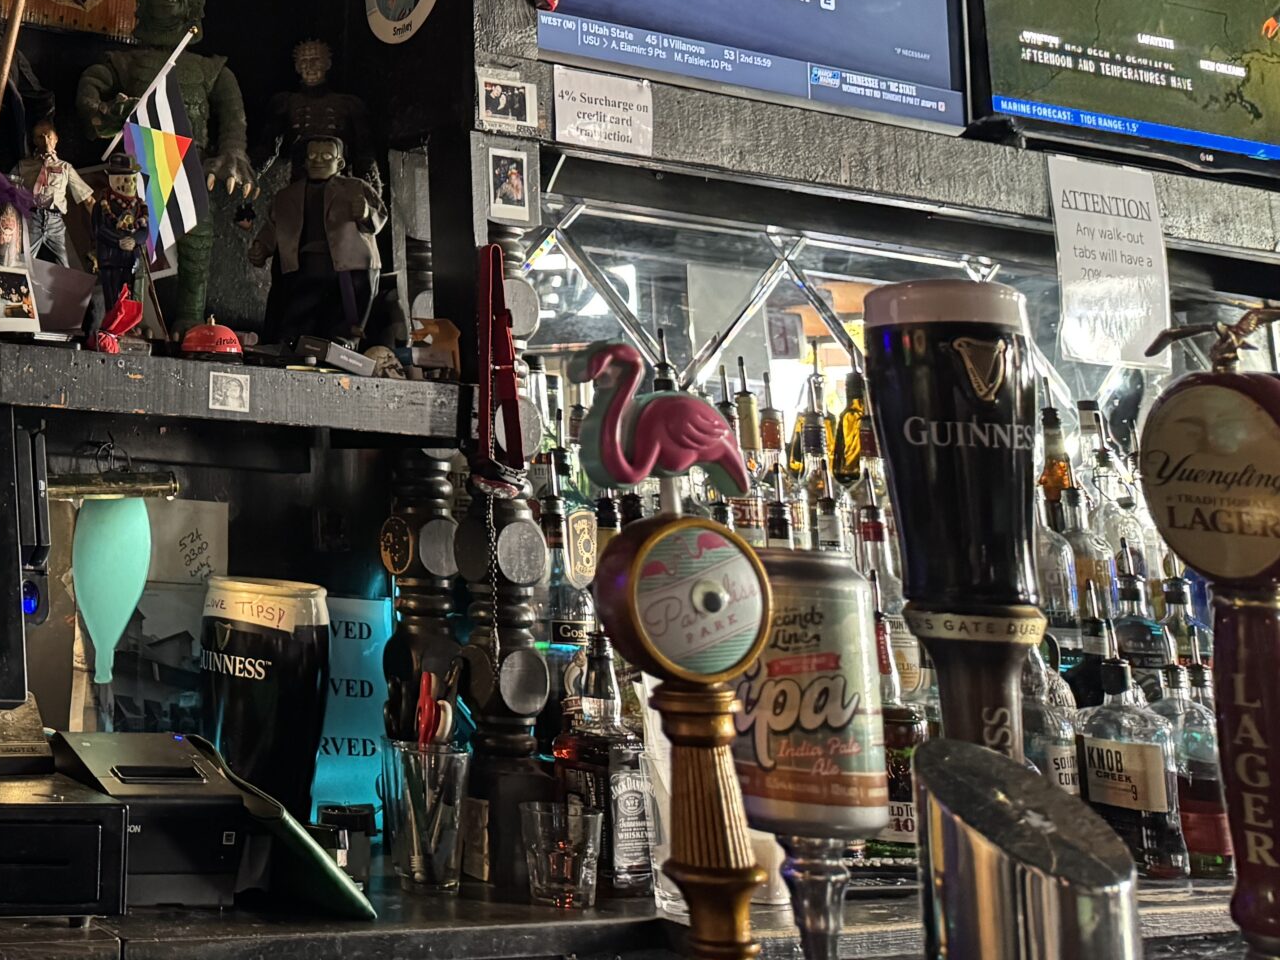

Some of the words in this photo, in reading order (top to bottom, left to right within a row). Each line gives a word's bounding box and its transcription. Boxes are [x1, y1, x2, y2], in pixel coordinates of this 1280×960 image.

[392, 20, 412, 36] Smiley
[540, 15, 562, 28] WEST
[588, 23, 610, 37] Utah
[610, 27, 634, 41] State
[645, 33, 658, 45] 45
[669, 38, 706, 55] Villanova
[723, 49, 735, 61] 53
[740, 54, 753, 64] 2nd
[583, 34, 600, 47] USU
[654, 48, 667, 59] Pts
[720, 60, 733, 72] Pts
[1021, 47, 1073, 70] AFTERNOON
[1078, 58, 1095, 73] AND
[1100, 61, 1167, 87] TEMPERATURES
[1170, 76, 1193, 91] HAVE
[558, 90, 576, 103] 4%
[579, 93, 634, 111] Surcharge
[636, 103, 650, 113] on
[576, 110, 608, 125] credit
[610, 115, 632, 127] card
[1001, 99, 1031, 115] MARINE
[1031, 104, 1074, 122] FORECAST:
[1080, 114, 1097, 126] TIDE
[1097, 116, 1125, 131] RANGE:
[1061, 188, 1152, 222] ATTENTION
[1075, 221, 1095, 240] Any
[1099, 226, 1144, 245] walk-out
[1073, 245, 1097, 260] tabs
[1099, 248, 1117, 263] will
[1120, 250, 1144, 267] have
[1146, 257, 1153, 268] a
[685, 614, 738, 644] PARK
[943, 619, 995, 634] GATE
[777, 739, 823, 759] India
[827, 738, 861, 757] Pale
[1087, 746, 1123, 773] KNOB
[1095, 770, 1132, 784] CREEK
[1131, 784, 1138, 802] 9
